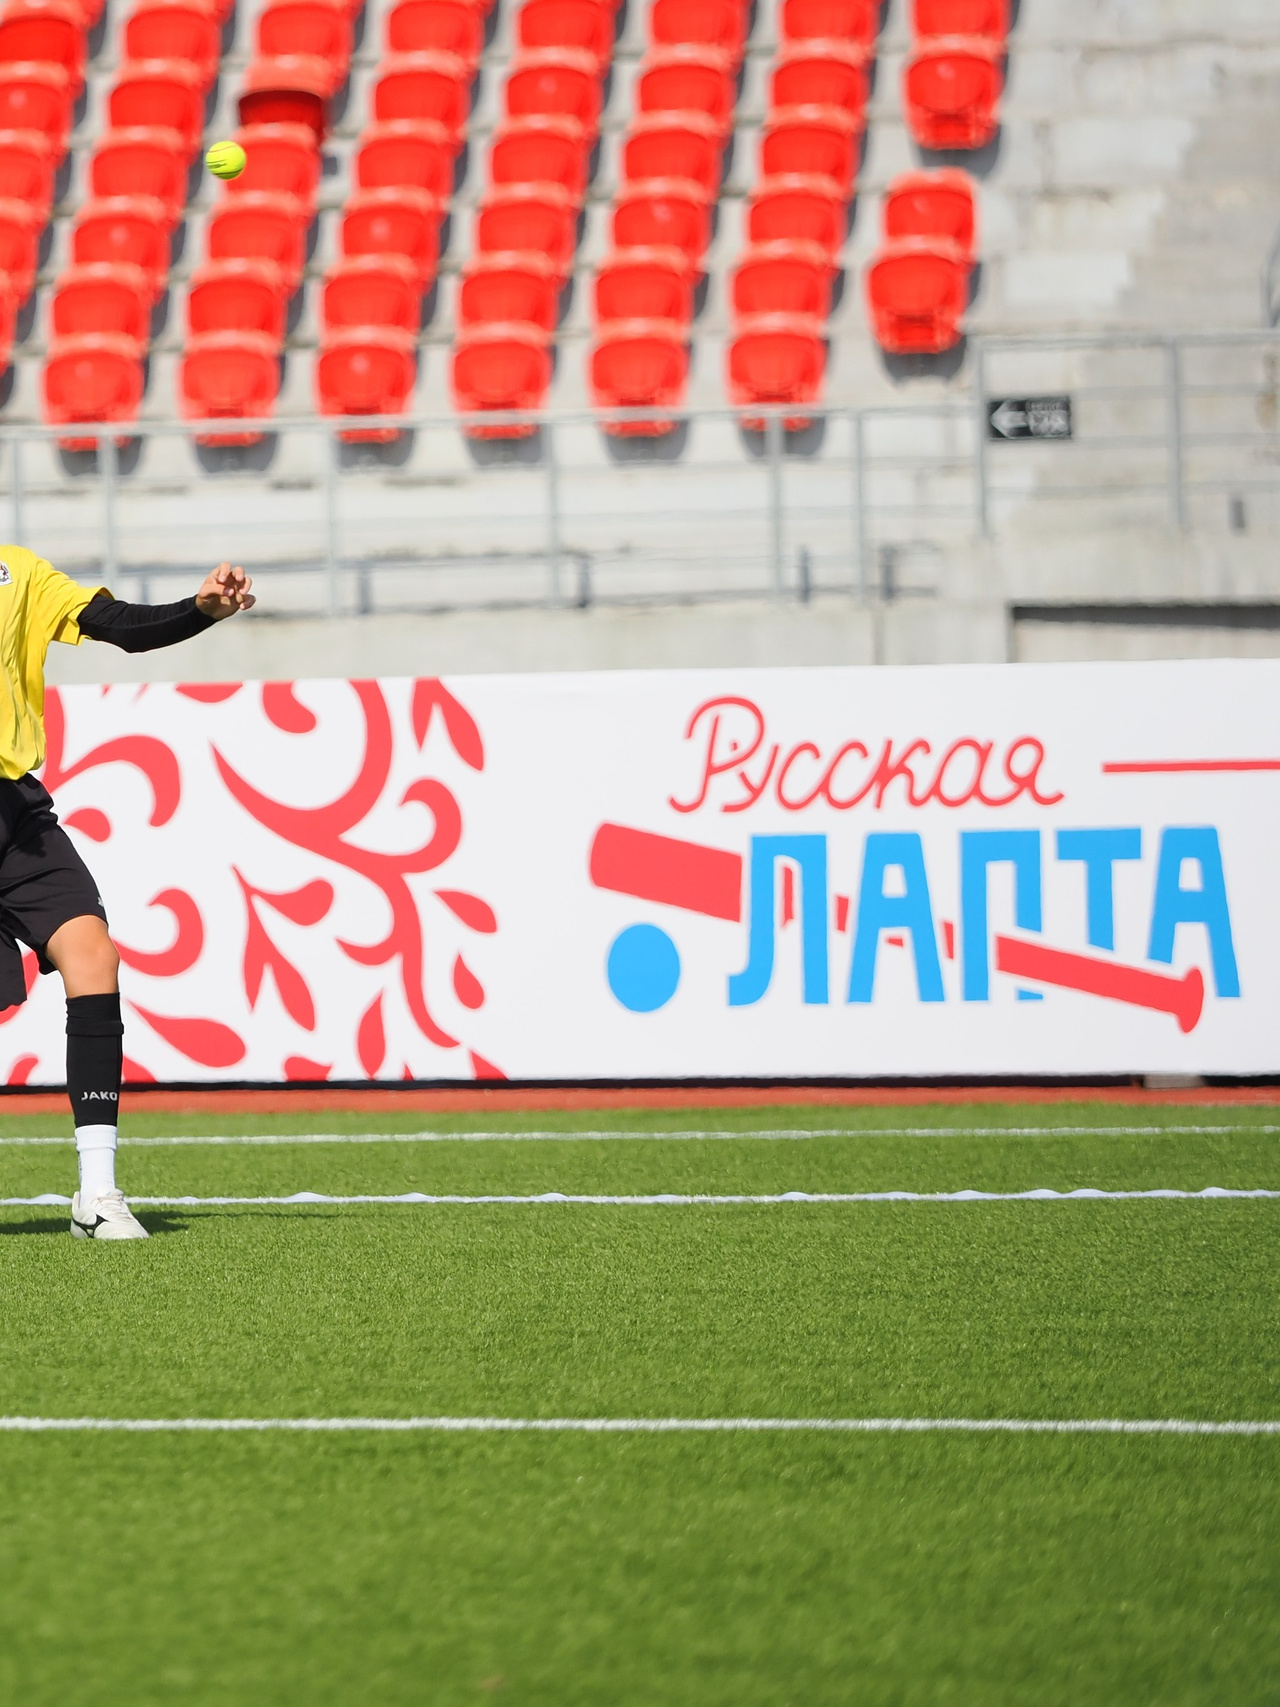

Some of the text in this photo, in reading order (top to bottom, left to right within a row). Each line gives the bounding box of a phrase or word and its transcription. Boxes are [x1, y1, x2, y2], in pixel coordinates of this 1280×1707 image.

[669, 695, 1065, 813] Русская
[728, 826, 1242, 1006] ЛАПТА
[81, 1091, 118, 1102] JAKO
